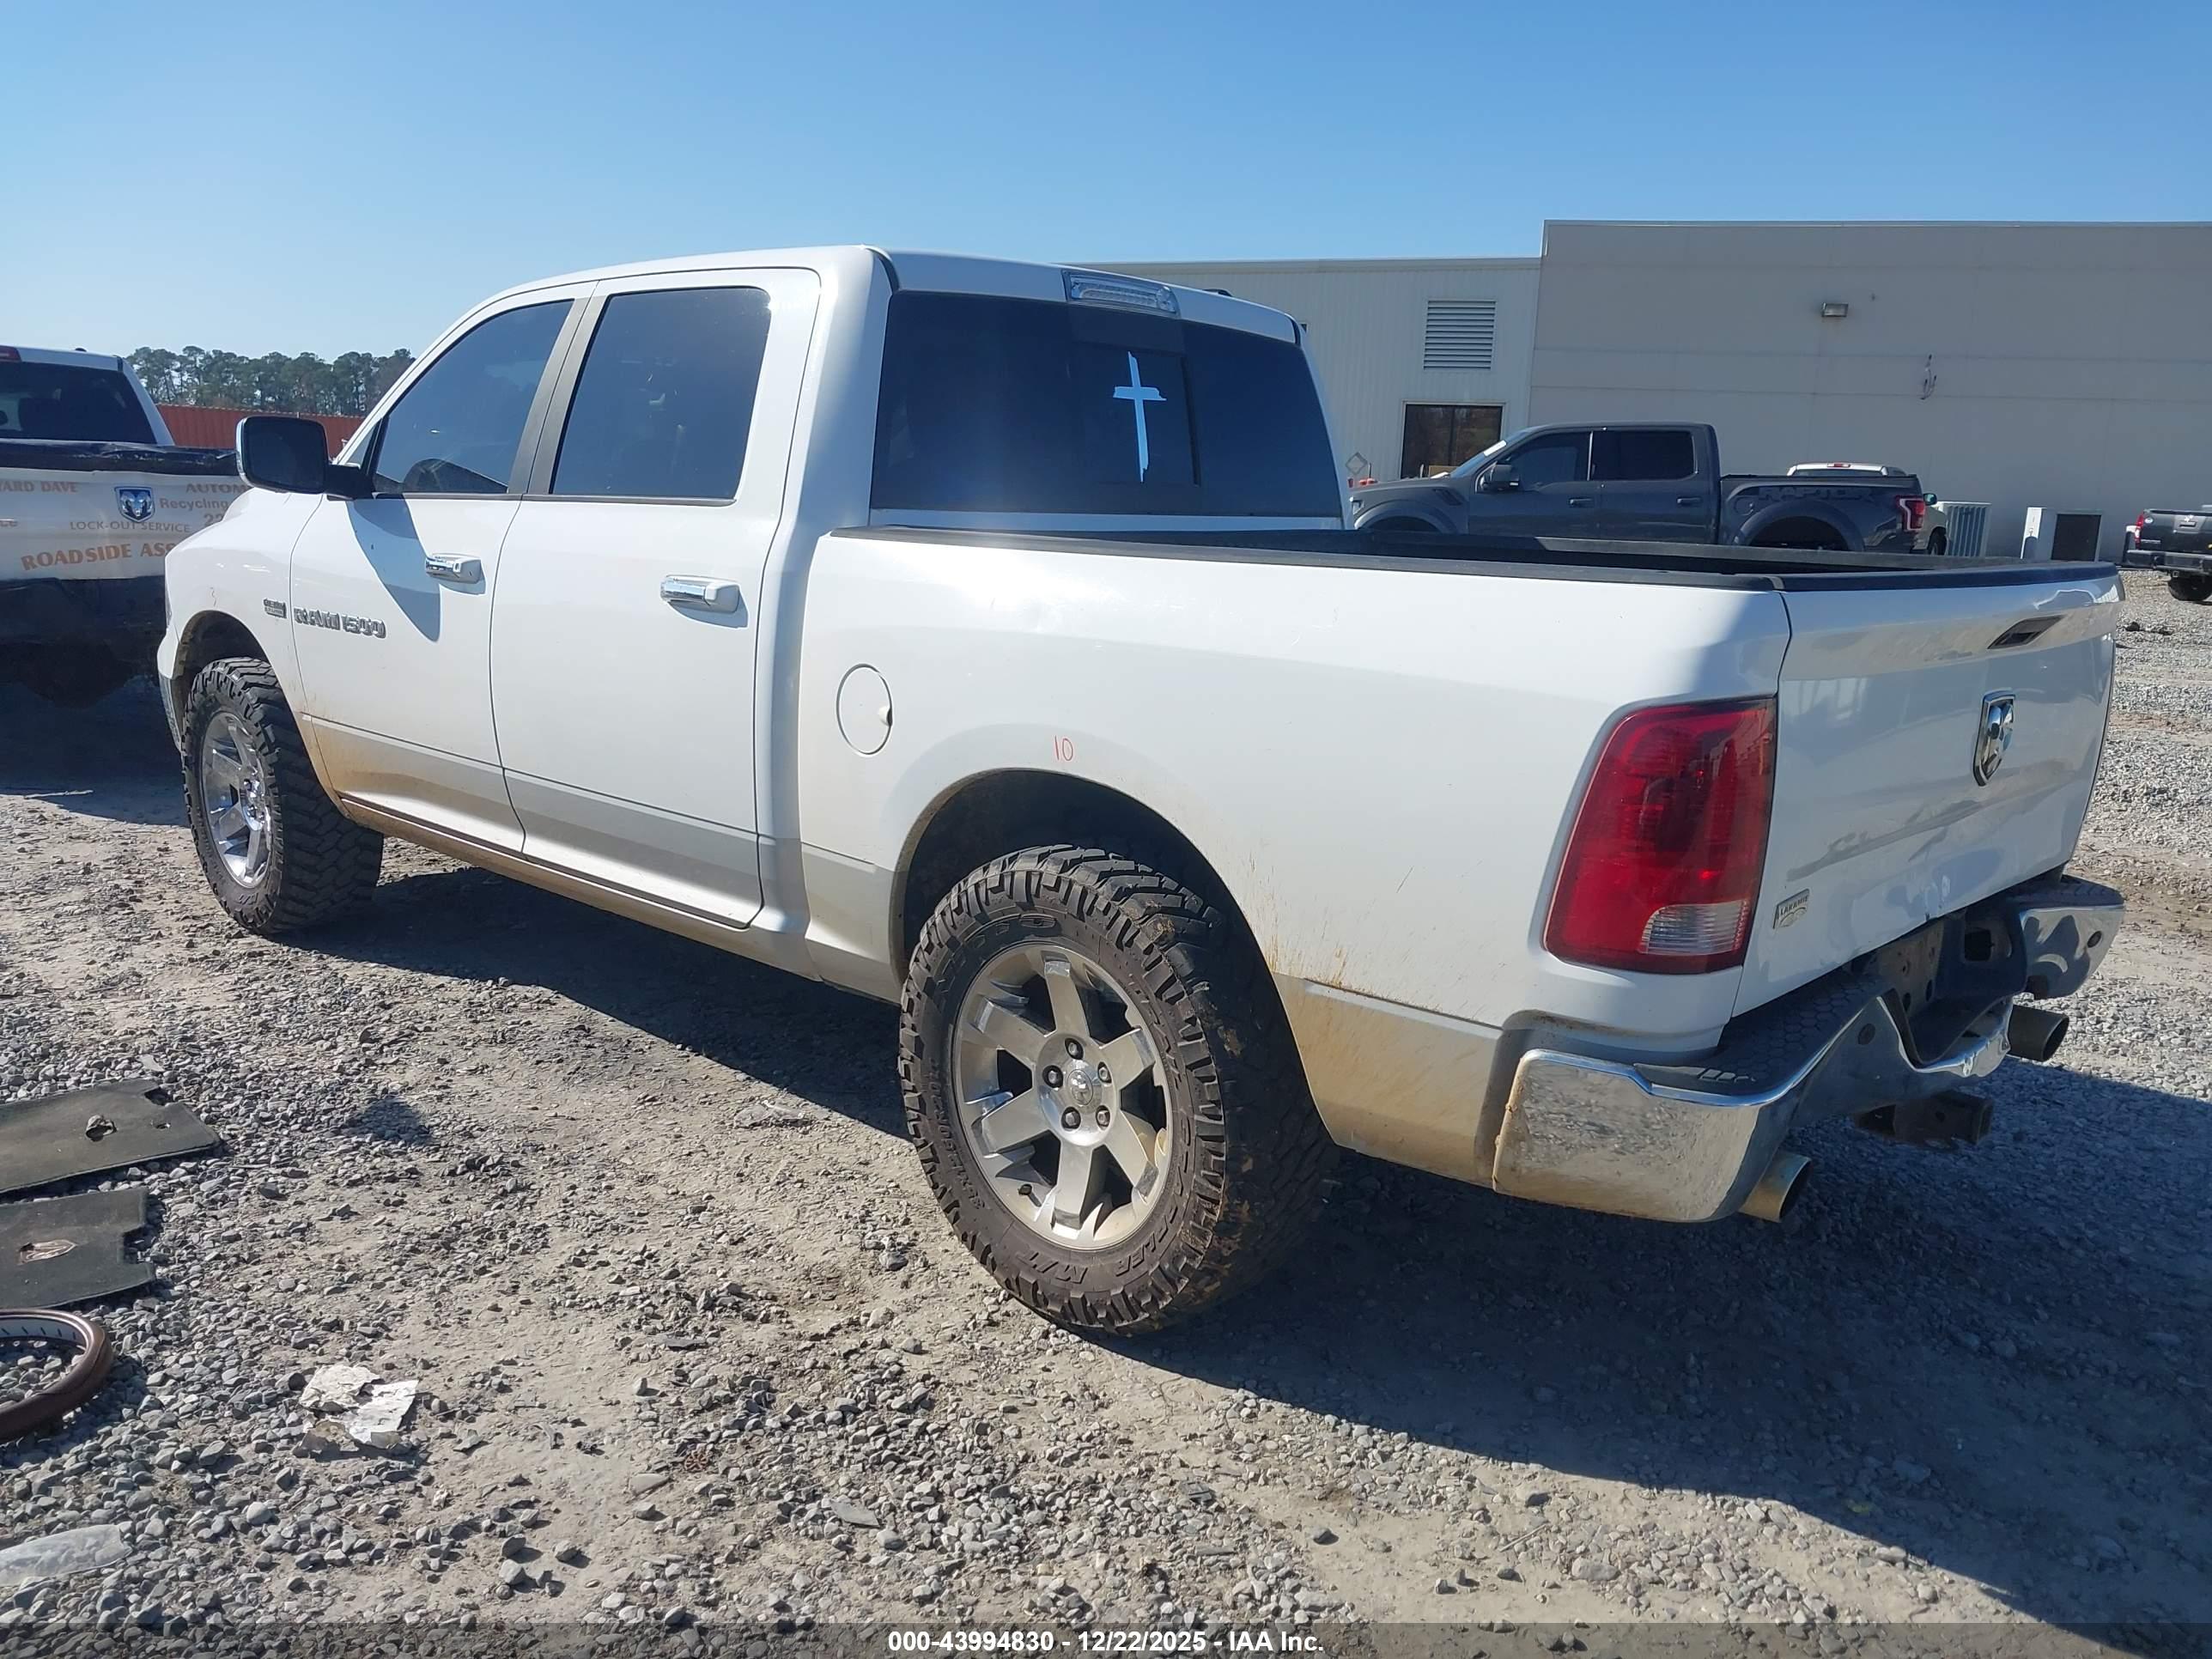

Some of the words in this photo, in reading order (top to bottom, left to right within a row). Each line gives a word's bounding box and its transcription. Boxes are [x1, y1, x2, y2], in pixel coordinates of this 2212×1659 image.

[0, 481, 35, 492] ARD
[40, 481, 78, 493] DAVE
[1759, 487, 1875, 502] RAPTOR
[70, 520, 136, 531] LOCK-OUT
[142, 521, 191, 533] SERVICE
[21, 543, 131, 571] ROADSIDE
[294, 608, 340, 630] RAM
[342, 614, 386, 639] 1500
[1054, 735, 1073, 761] 10
[1115, 1116, 1193, 1278] GRAPPLER
